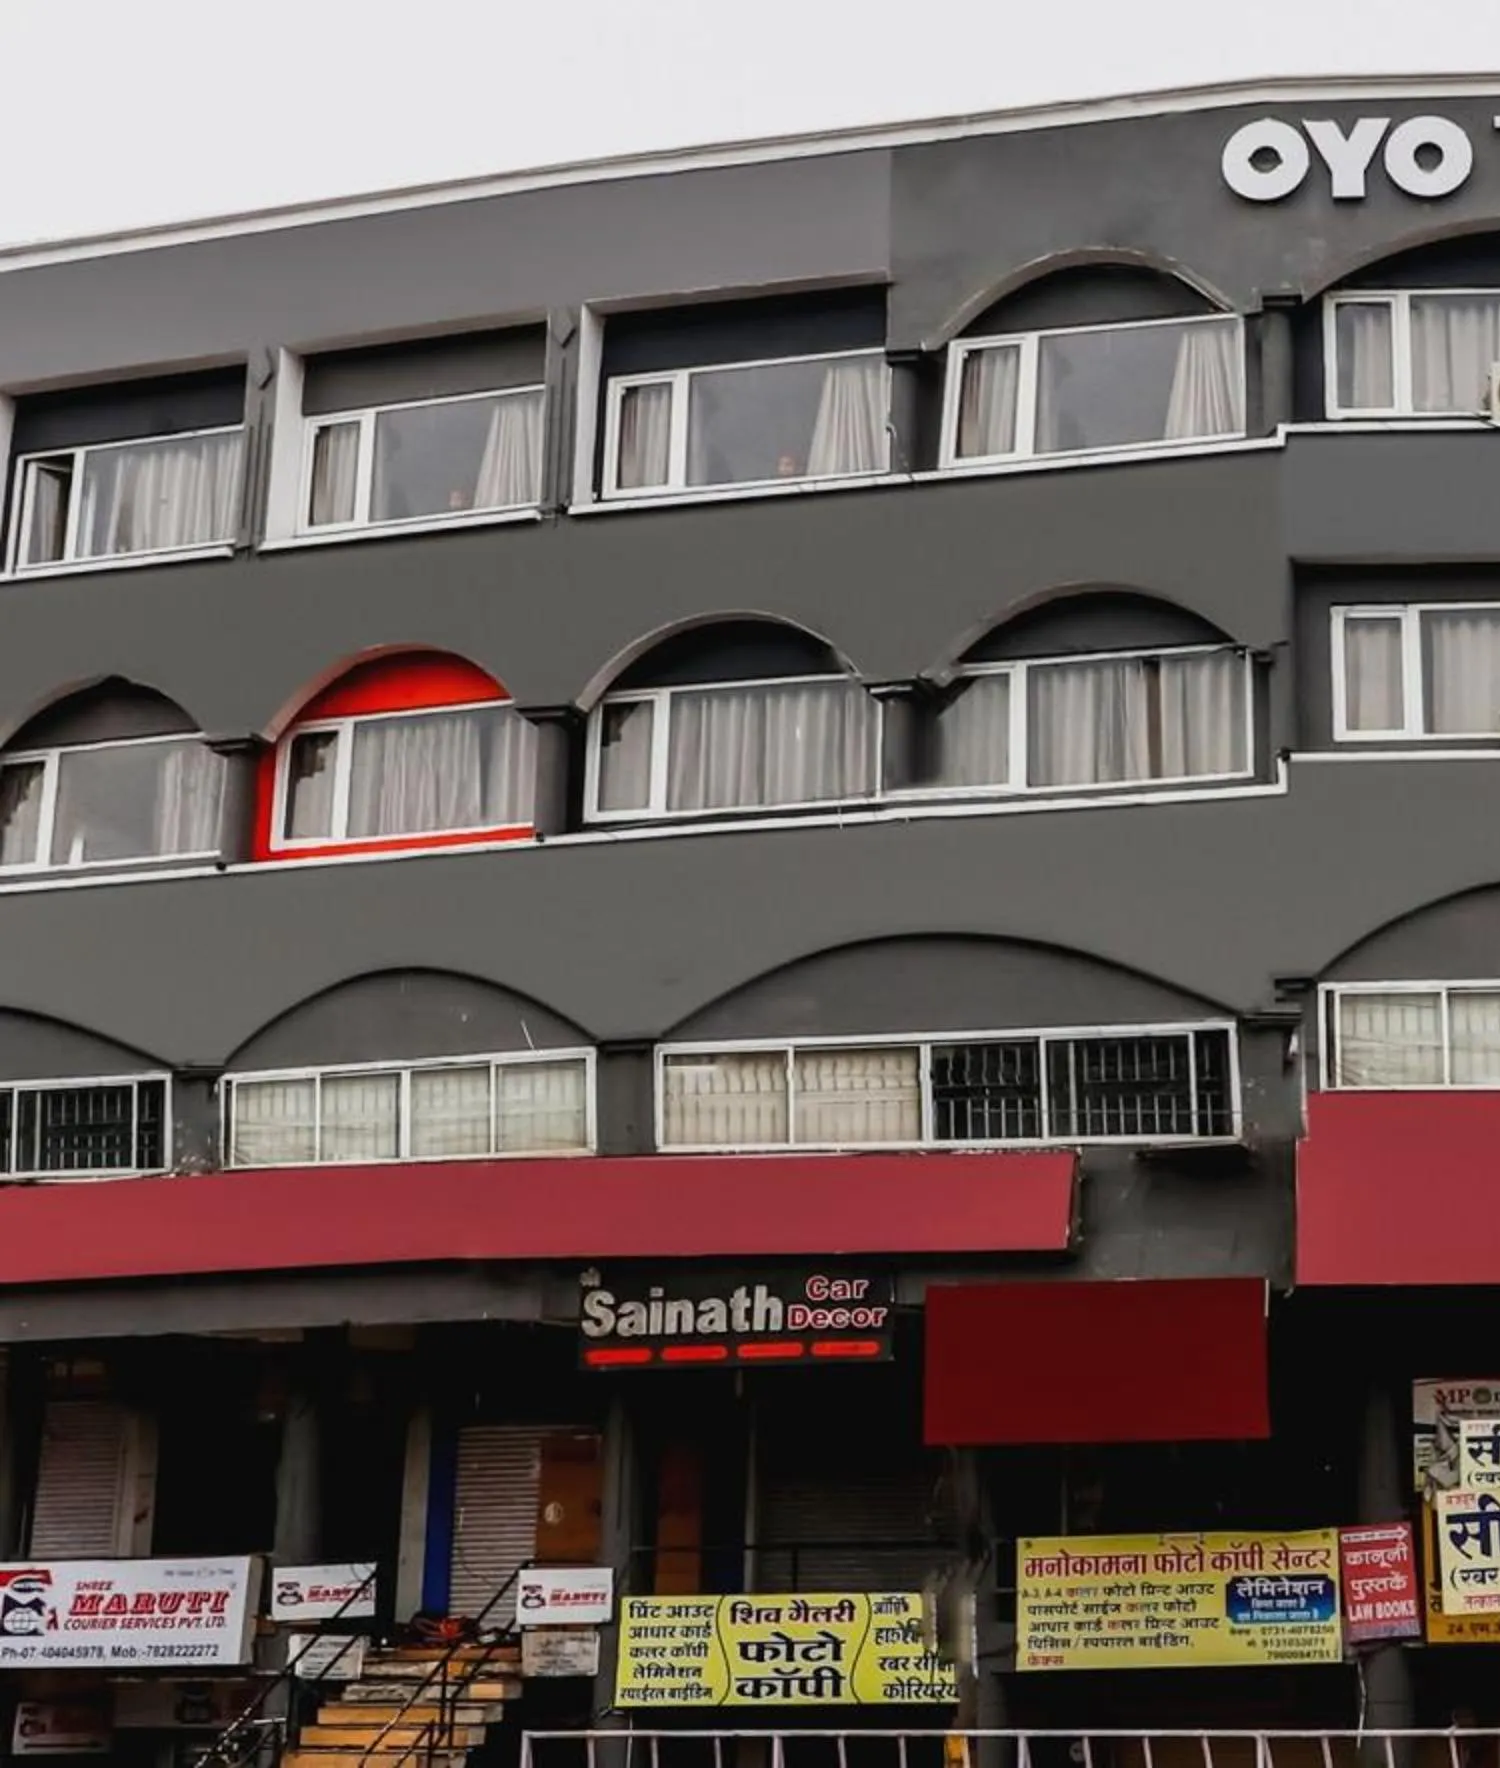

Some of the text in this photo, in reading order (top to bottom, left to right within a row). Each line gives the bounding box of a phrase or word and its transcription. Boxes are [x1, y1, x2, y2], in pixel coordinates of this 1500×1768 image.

[1220, 115, 1474, 202] OYO
[805, 1275, 870, 1300] Car
[581, 1285, 784, 1337] Sainath
[787, 1306, 888, 1330] Decor
[1024, 1541, 1331, 1578] मनोकामना फोटो कॉपी सेन्टर
[1344, 1541, 1408, 1568] कानूनी
[75, 1580, 114, 1591] SHREE
[1103, 1582, 1136, 1598] फोटो
[1175, 1582, 1216, 1596] आउट
[1236, 1575, 1325, 1598] लेमिनेशन
[1450, 1565, 1499, 1591] (रबर
[68, 1591, 230, 1616] MARUTI
[666, 1604, 715, 1620] आउट
[730, 1597, 856, 1625] शिव गैलरी
[1162, 1598, 1197, 1613] फोटो
[1349, 1603, 1374, 1622] LAW
[1376, 1599, 1416, 1618] BOOKS
[63, 1617, 117, 1631] COURIER
[119, 1616, 176, 1630] SERVICES
[628, 1620, 713, 1640] आधार कार्ड
[1029, 1619, 1069, 1633] आधार
[629, 1641, 709, 1659] कलर कॉपी
[736, 1630, 846, 1663] फोटो
[735, 1665, 846, 1699] कॉपी
